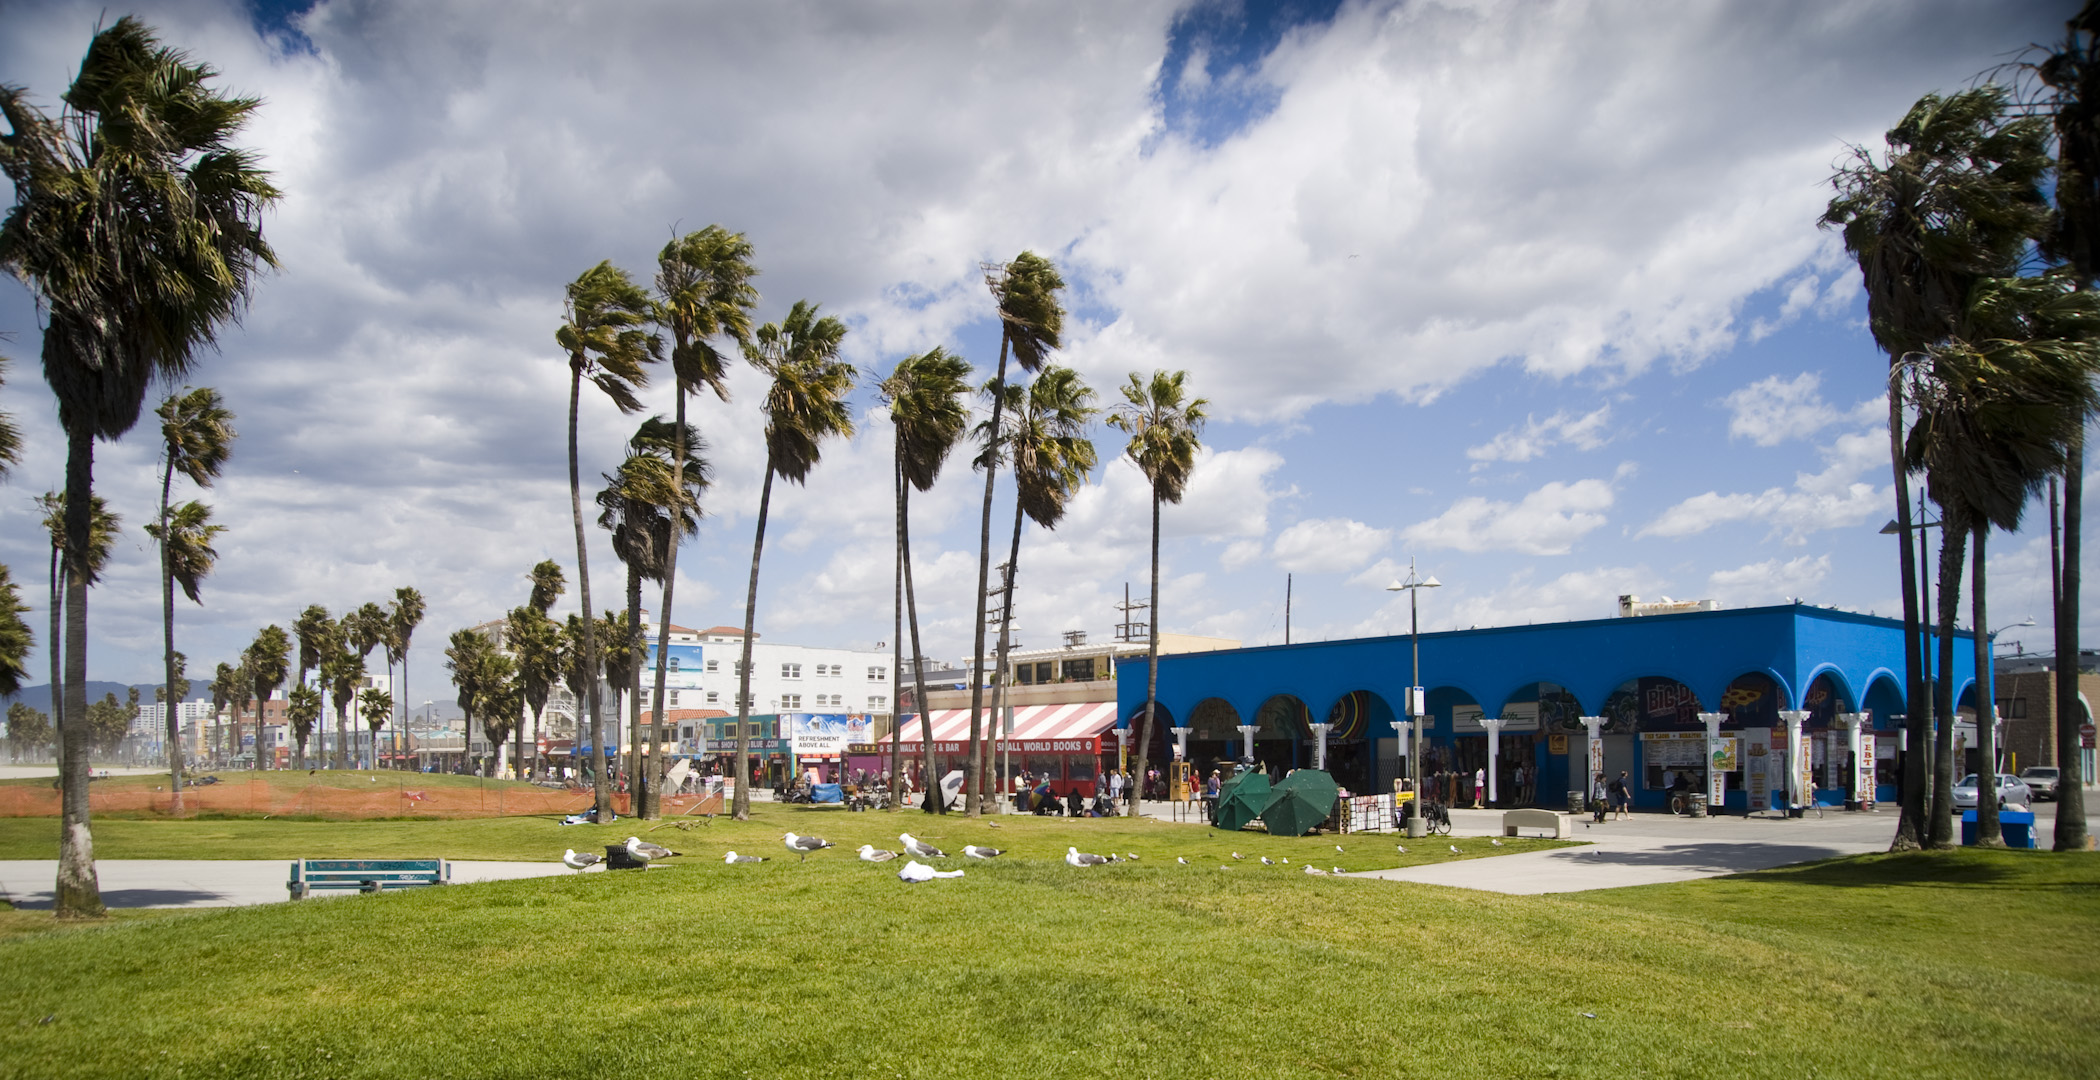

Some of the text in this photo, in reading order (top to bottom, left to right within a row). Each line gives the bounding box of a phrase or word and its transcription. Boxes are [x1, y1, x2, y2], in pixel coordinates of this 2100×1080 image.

[721, 740, 734, 749] SHOP
[750, 740, 763, 748] BLUE
[887, 743, 960, 753] SIWALK CE & BAR
[1023, 741, 1051, 751] WORLD
[1053, 740, 1082, 751] BOOKS
[1863, 743, 1872, 766] EBT
